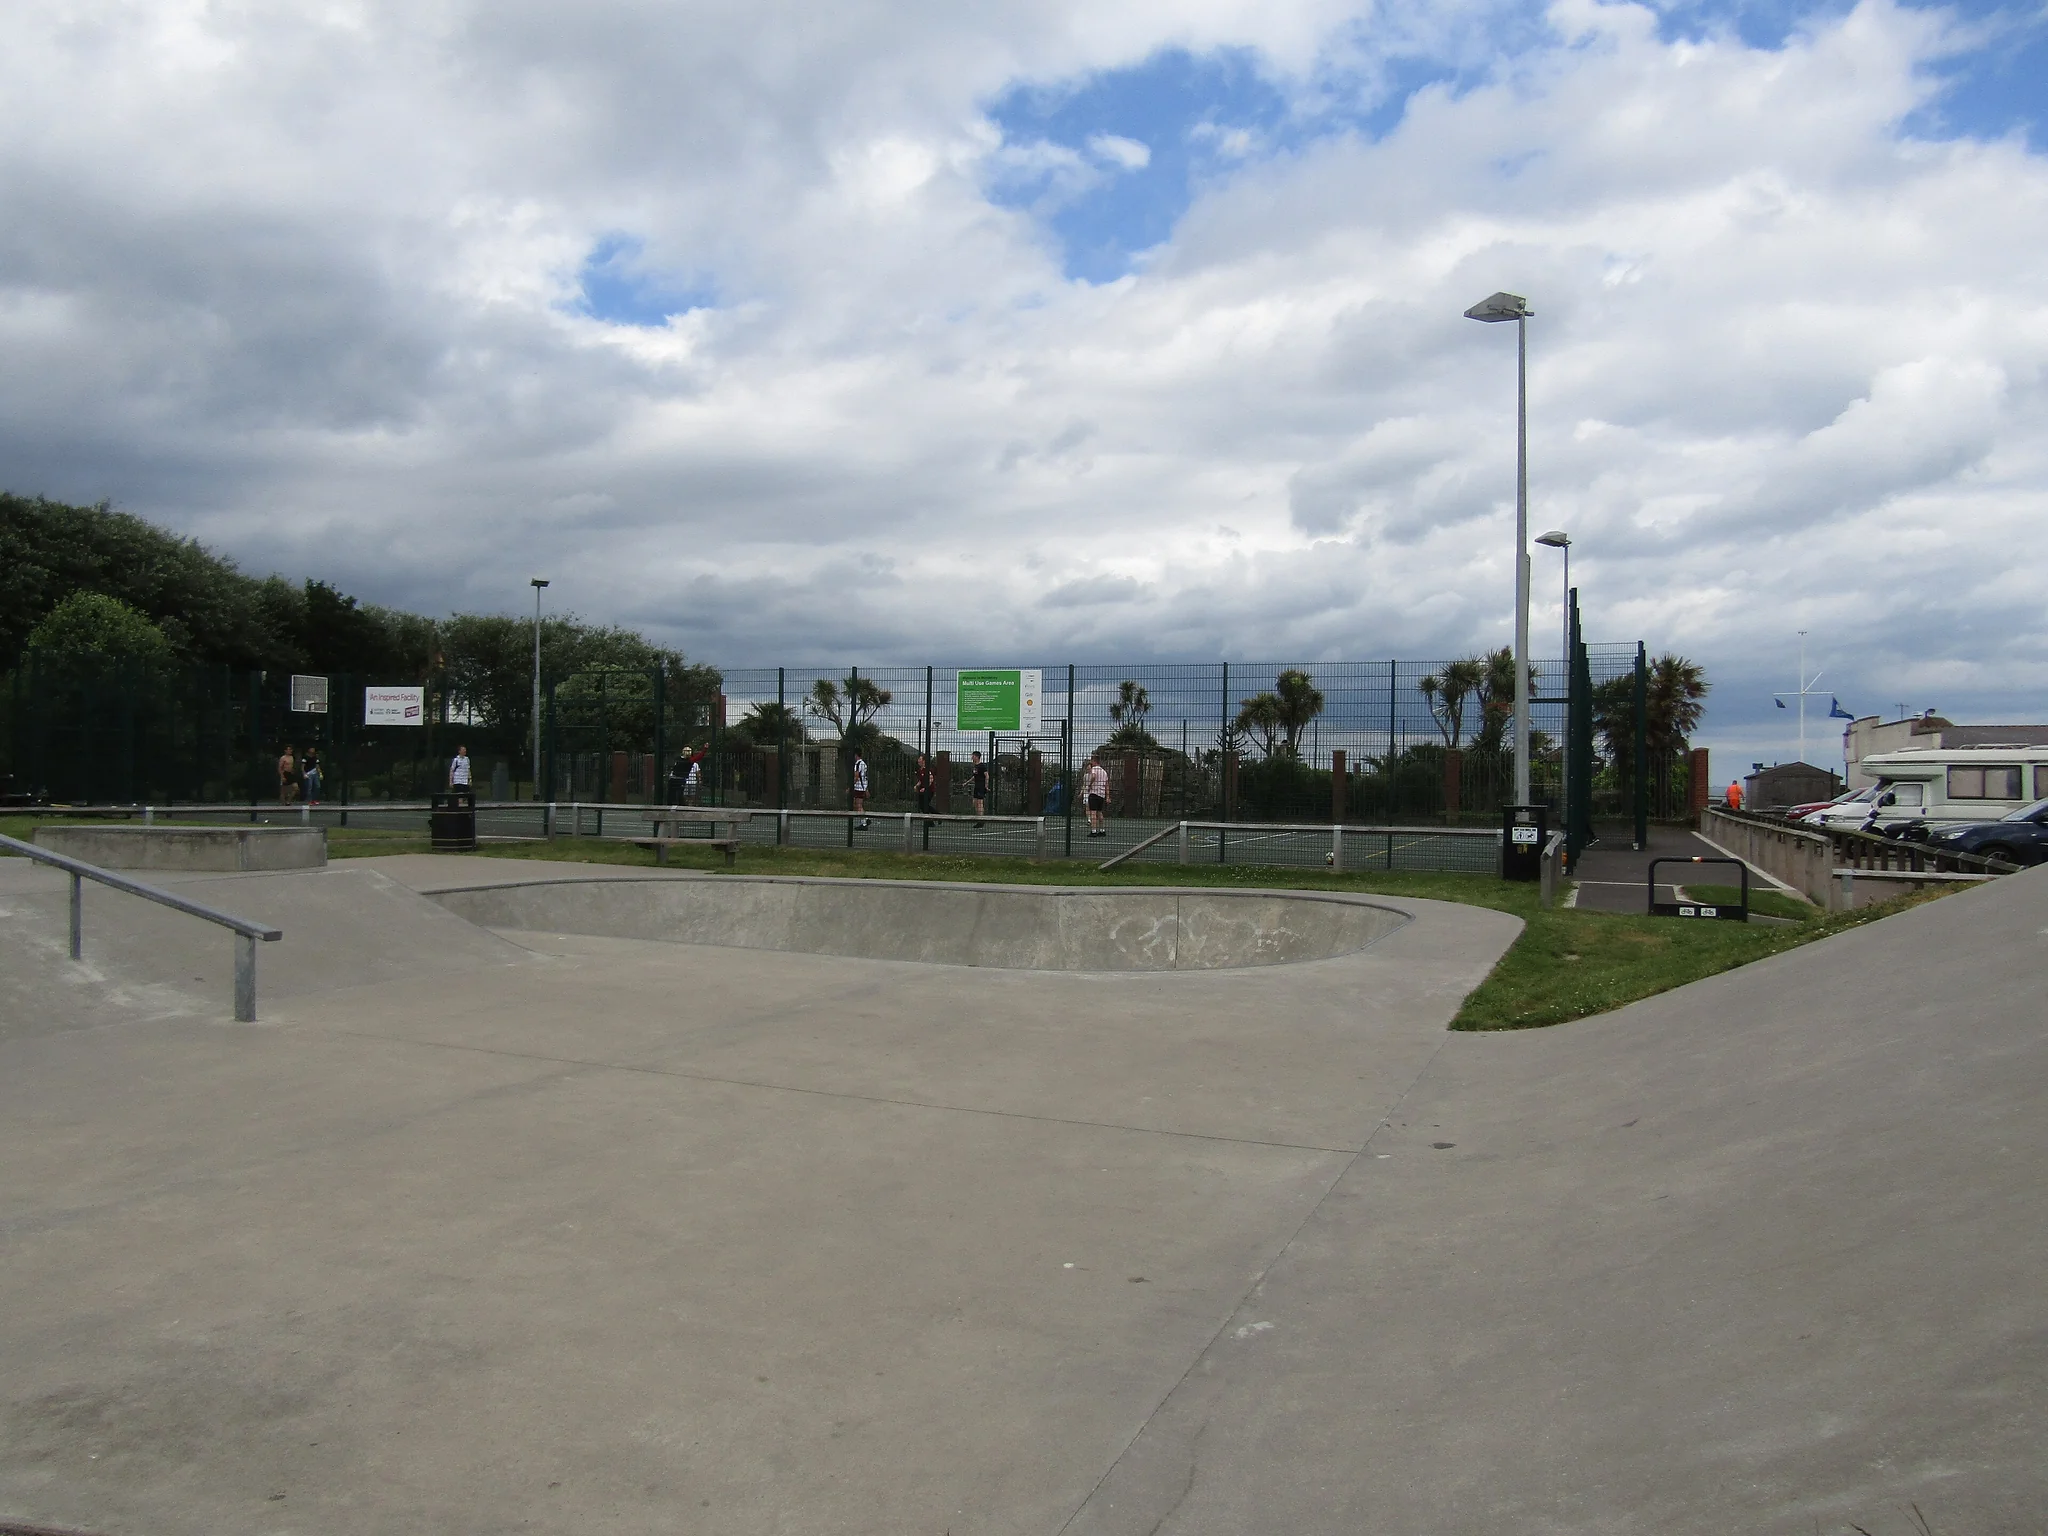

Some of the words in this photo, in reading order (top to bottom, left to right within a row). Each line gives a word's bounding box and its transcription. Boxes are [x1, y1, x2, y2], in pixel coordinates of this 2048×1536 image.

[370, 693, 378, 701] An
[379, 693, 400, 702] Inspired
[401, 693, 420, 703] Facility
